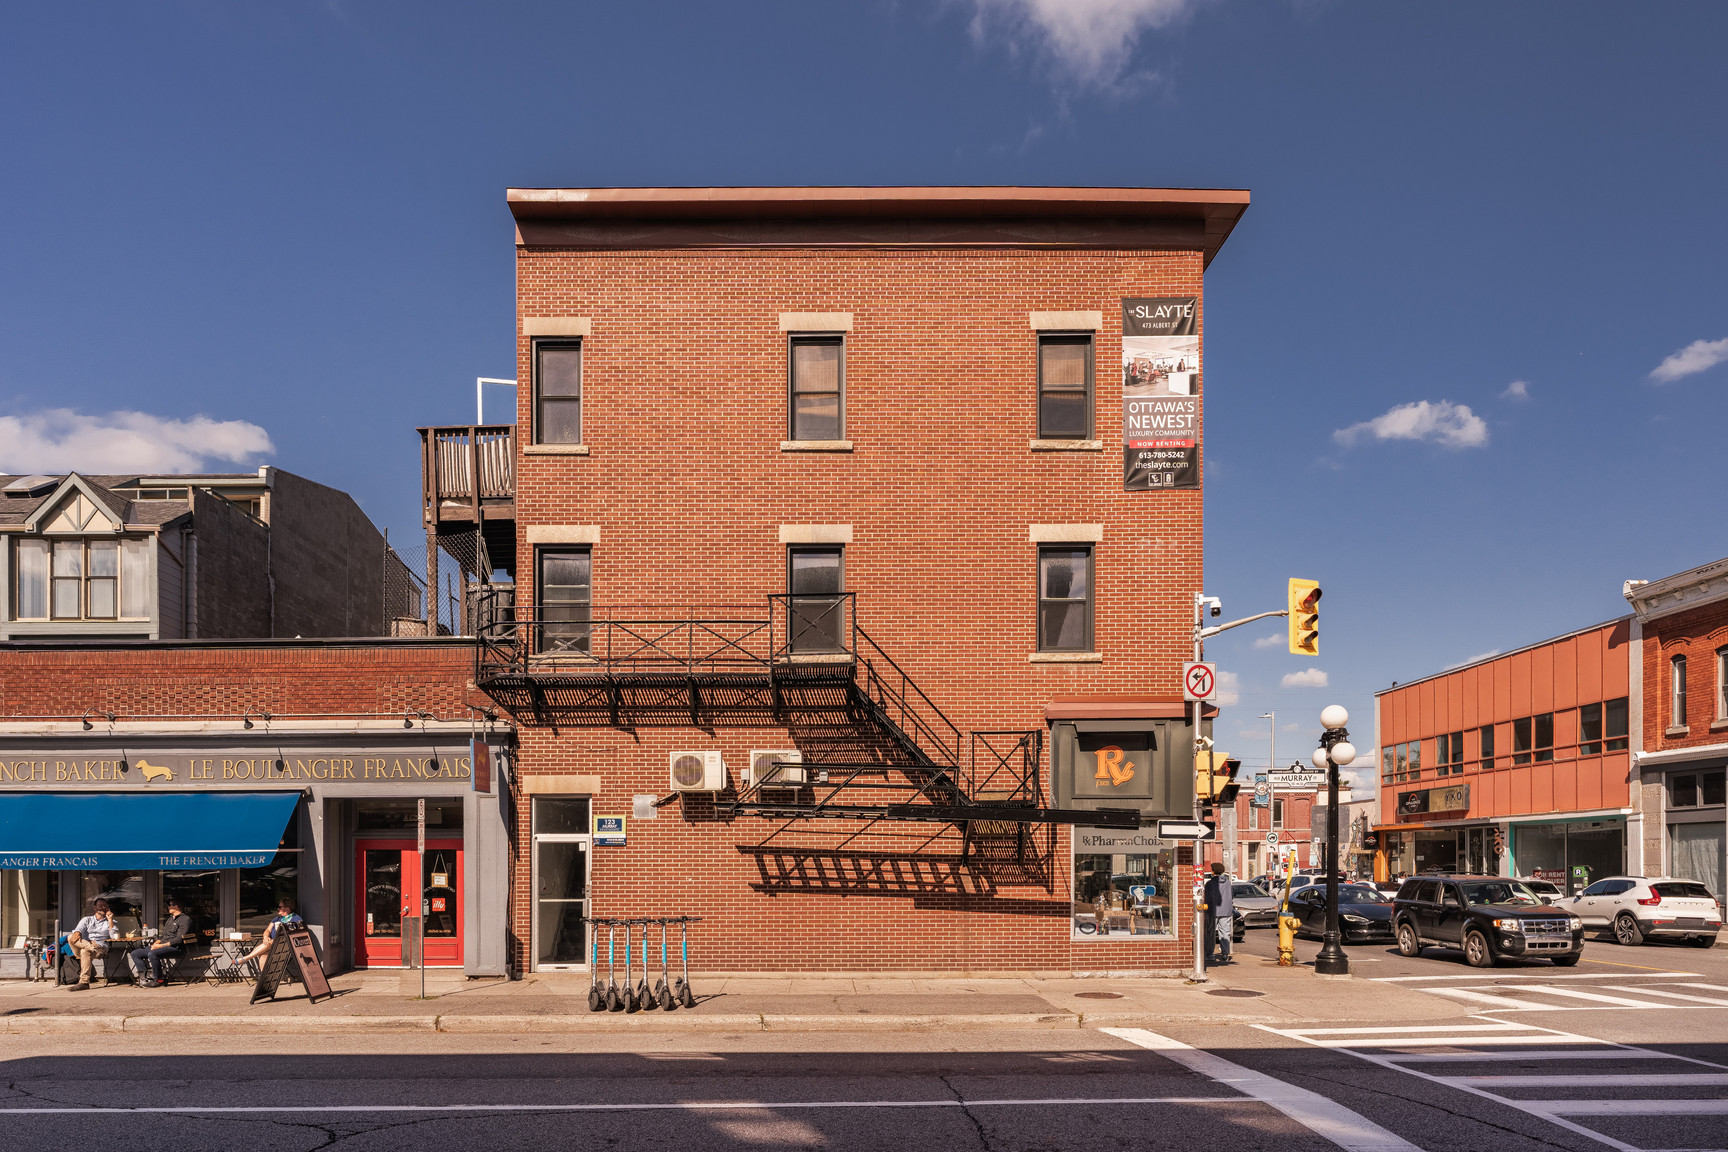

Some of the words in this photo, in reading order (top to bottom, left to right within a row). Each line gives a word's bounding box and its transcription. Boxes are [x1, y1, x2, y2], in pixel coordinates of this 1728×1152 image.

[1136, 304, 1193, 319] SLAYTE
[1153, 321, 1171, 329] ALBERT
[1129, 401, 1195, 414] OTTAWA'S
[1129, 414, 1195, 429] NEWEST
[1155, 429, 1195, 437] COMMUNITY
[1138, 451, 1185, 459] 613-780-5242
[1135, 461, 1189, 470] theslayte.com
[55, 760, 126, 781] BAKER
[189, 759, 214, 780] LE
[222, 758, 356, 781] BOULANGER
[364, 757, 471, 780] FRANÇAIS
[1281, 774, 1313, 782] MURRAY
[159, 856, 181, 866] THE
[183, 856, 227, 866] FRENCH
[229, 854, 267, 866] BAKER
[432, 899, 445, 910] illy
